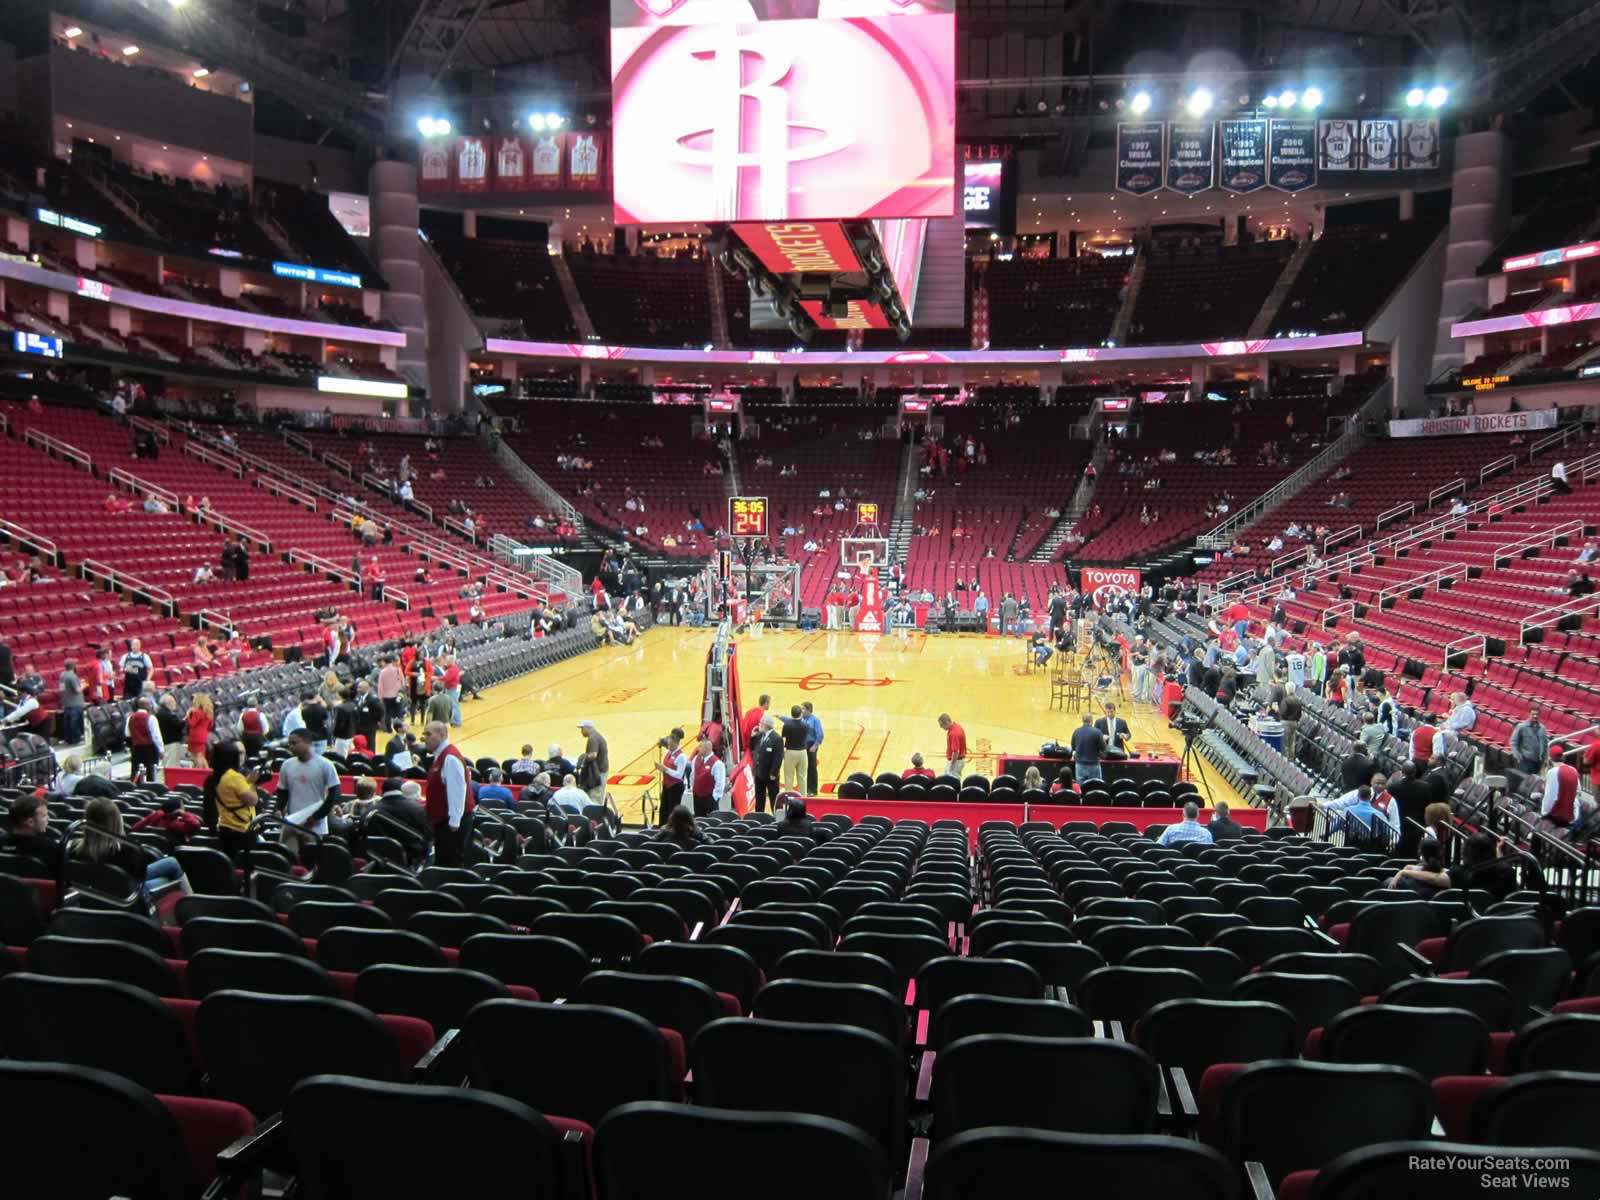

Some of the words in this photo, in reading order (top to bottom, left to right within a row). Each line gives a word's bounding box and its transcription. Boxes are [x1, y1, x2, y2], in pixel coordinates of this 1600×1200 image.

[1130, 142, 1151, 150] 1997
[1120, 160, 1161, 169] Champions
[1424, 418, 1470, 434] HOUSTON
[1474, 414, 1527, 432] ROCKETS
[734, 501, 764, 512] 36:05
[736, 513, 761, 532] 24
[1086, 571, 1136, 585] TOYOTA
